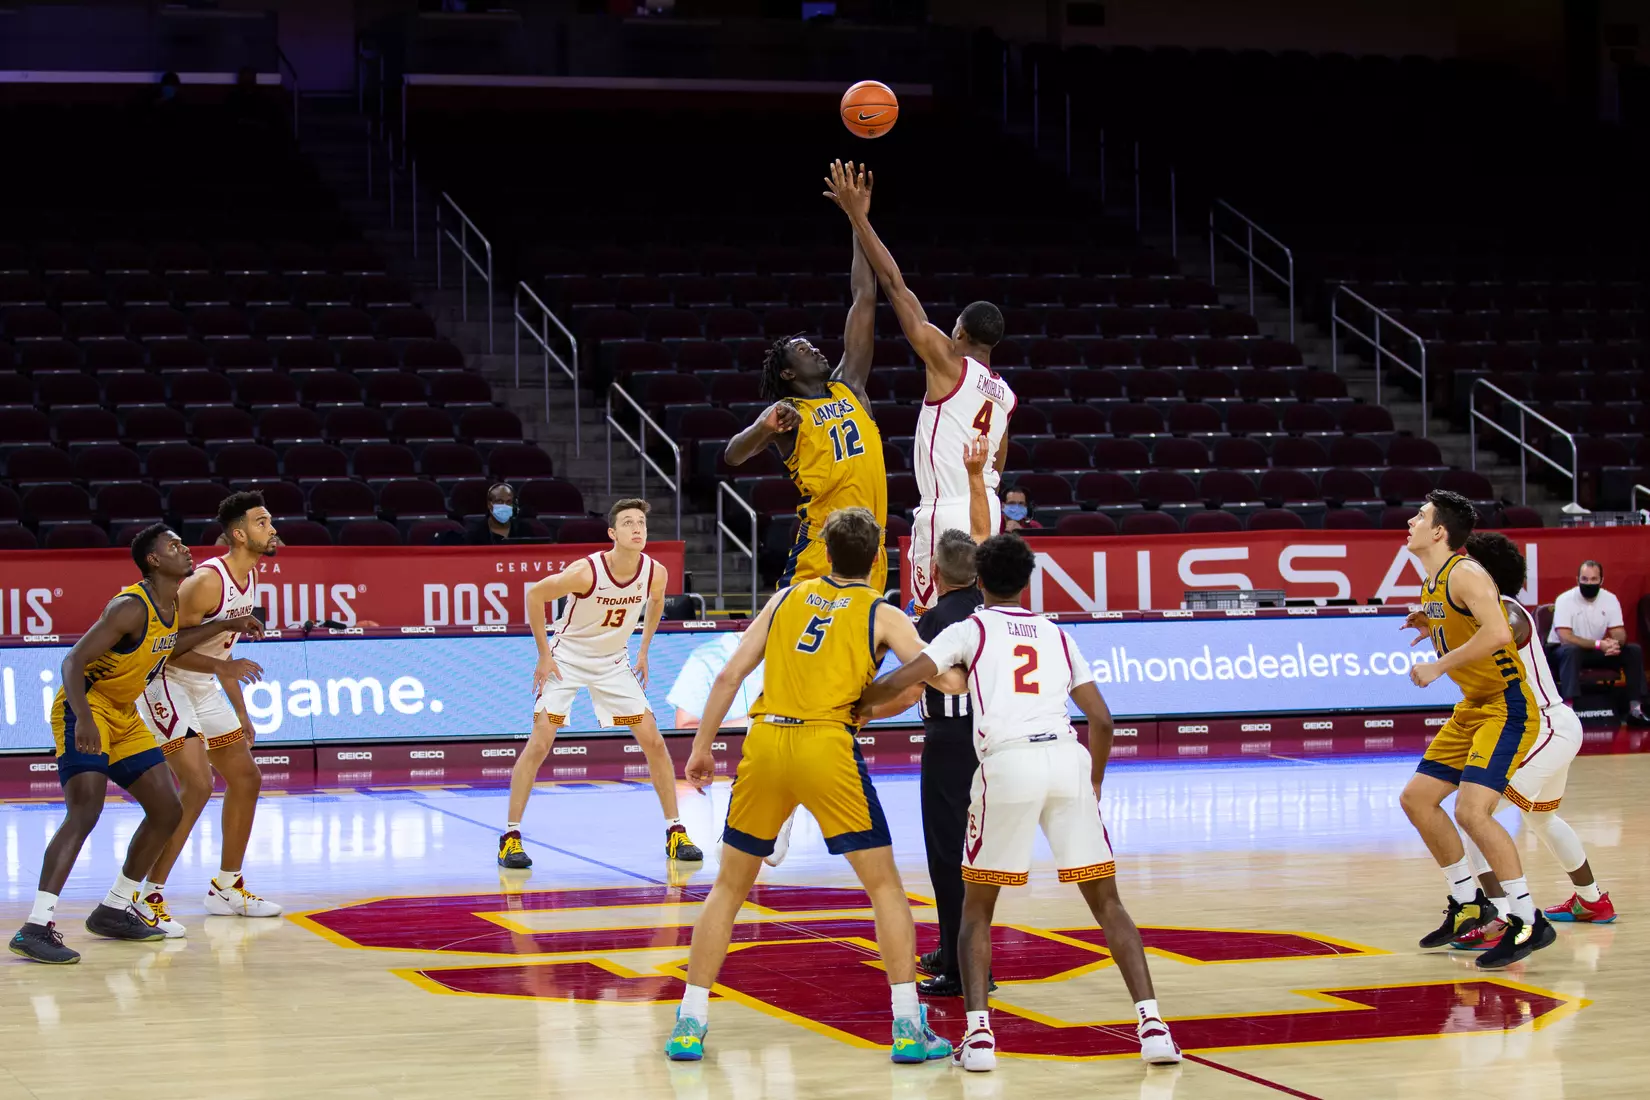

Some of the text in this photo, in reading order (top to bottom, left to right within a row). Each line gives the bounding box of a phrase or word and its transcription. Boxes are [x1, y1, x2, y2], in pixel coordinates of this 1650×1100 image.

[971, 399, 994, 442] 4
[828, 419, 865, 463] 12
[496, 561, 566, 573] CERVEZ
[1030, 543, 1538, 613] NISSA
[423, 582, 508, 626] DOS
[596, 595, 643, 606] TROJANS
[225, 605, 253, 619] TROJANS
[600, 608, 628, 628] 13
[795, 614, 834, 654] 5
[1007, 621, 1038, 638] EADDY
[1013, 643, 1041, 695] 2
[242, 676, 445, 735] game.
[1241, 723, 1271, 732] GEICO
[1303, 721, 1333, 730] GEICO
[1364, 720, 1394, 728] GEICO
[1425, 718, 1450, 726] GEIC
[1113, 727, 1138, 736] EICO
[1178, 725, 1208, 734] GEICO
[337, 751, 373, 762] GEICO
[410, 750, 445, 760] GEICO
[482, 748, 516, 758] GEICO
[553, 746, 587, 756] GEICO
[29, 763, 59, 772] GEIC
